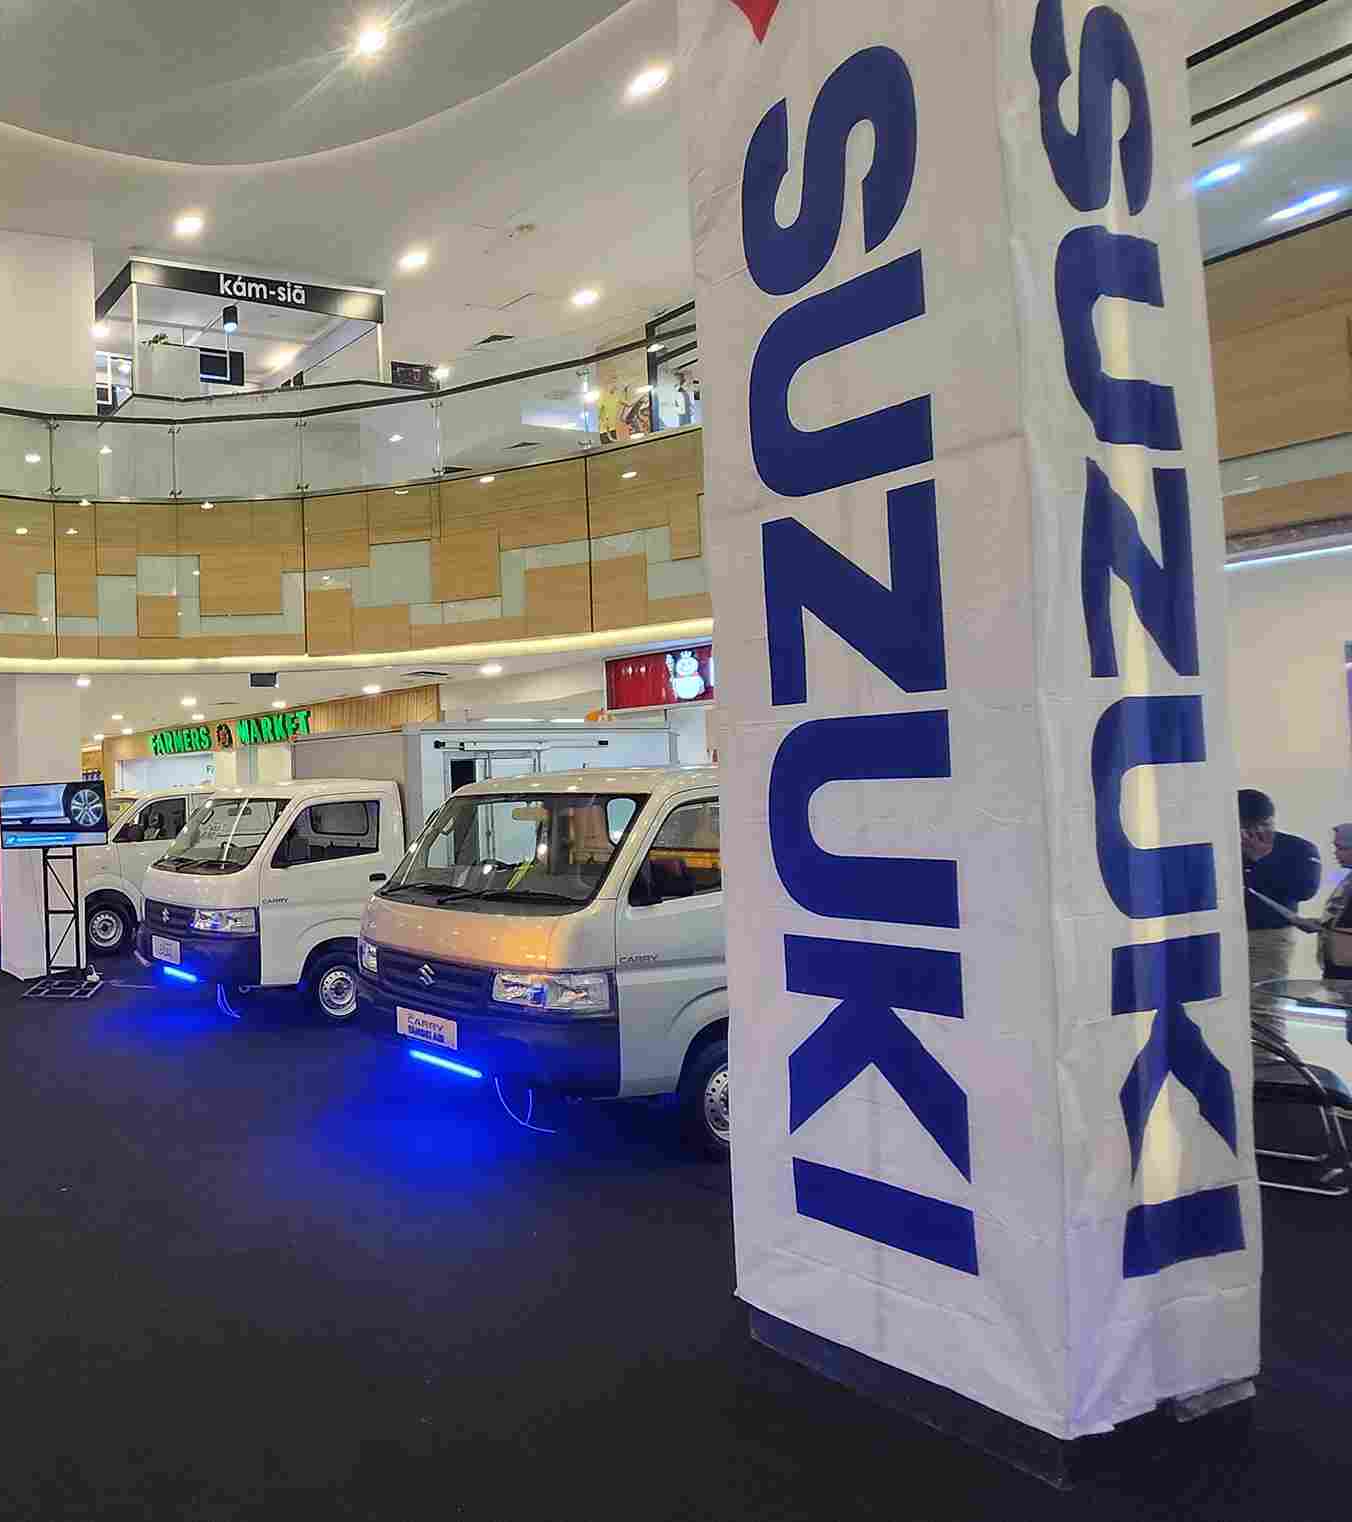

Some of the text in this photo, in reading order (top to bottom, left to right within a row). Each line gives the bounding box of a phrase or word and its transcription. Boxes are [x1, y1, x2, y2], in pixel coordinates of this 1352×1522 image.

[219, 273, 306, 305] kám-siā
[151, 710, 312, 756] FARMERS MARKET
[742, 45, 980, 1277] SUZUKI
[1030, 0, 1247, 1279] SUZUKI
